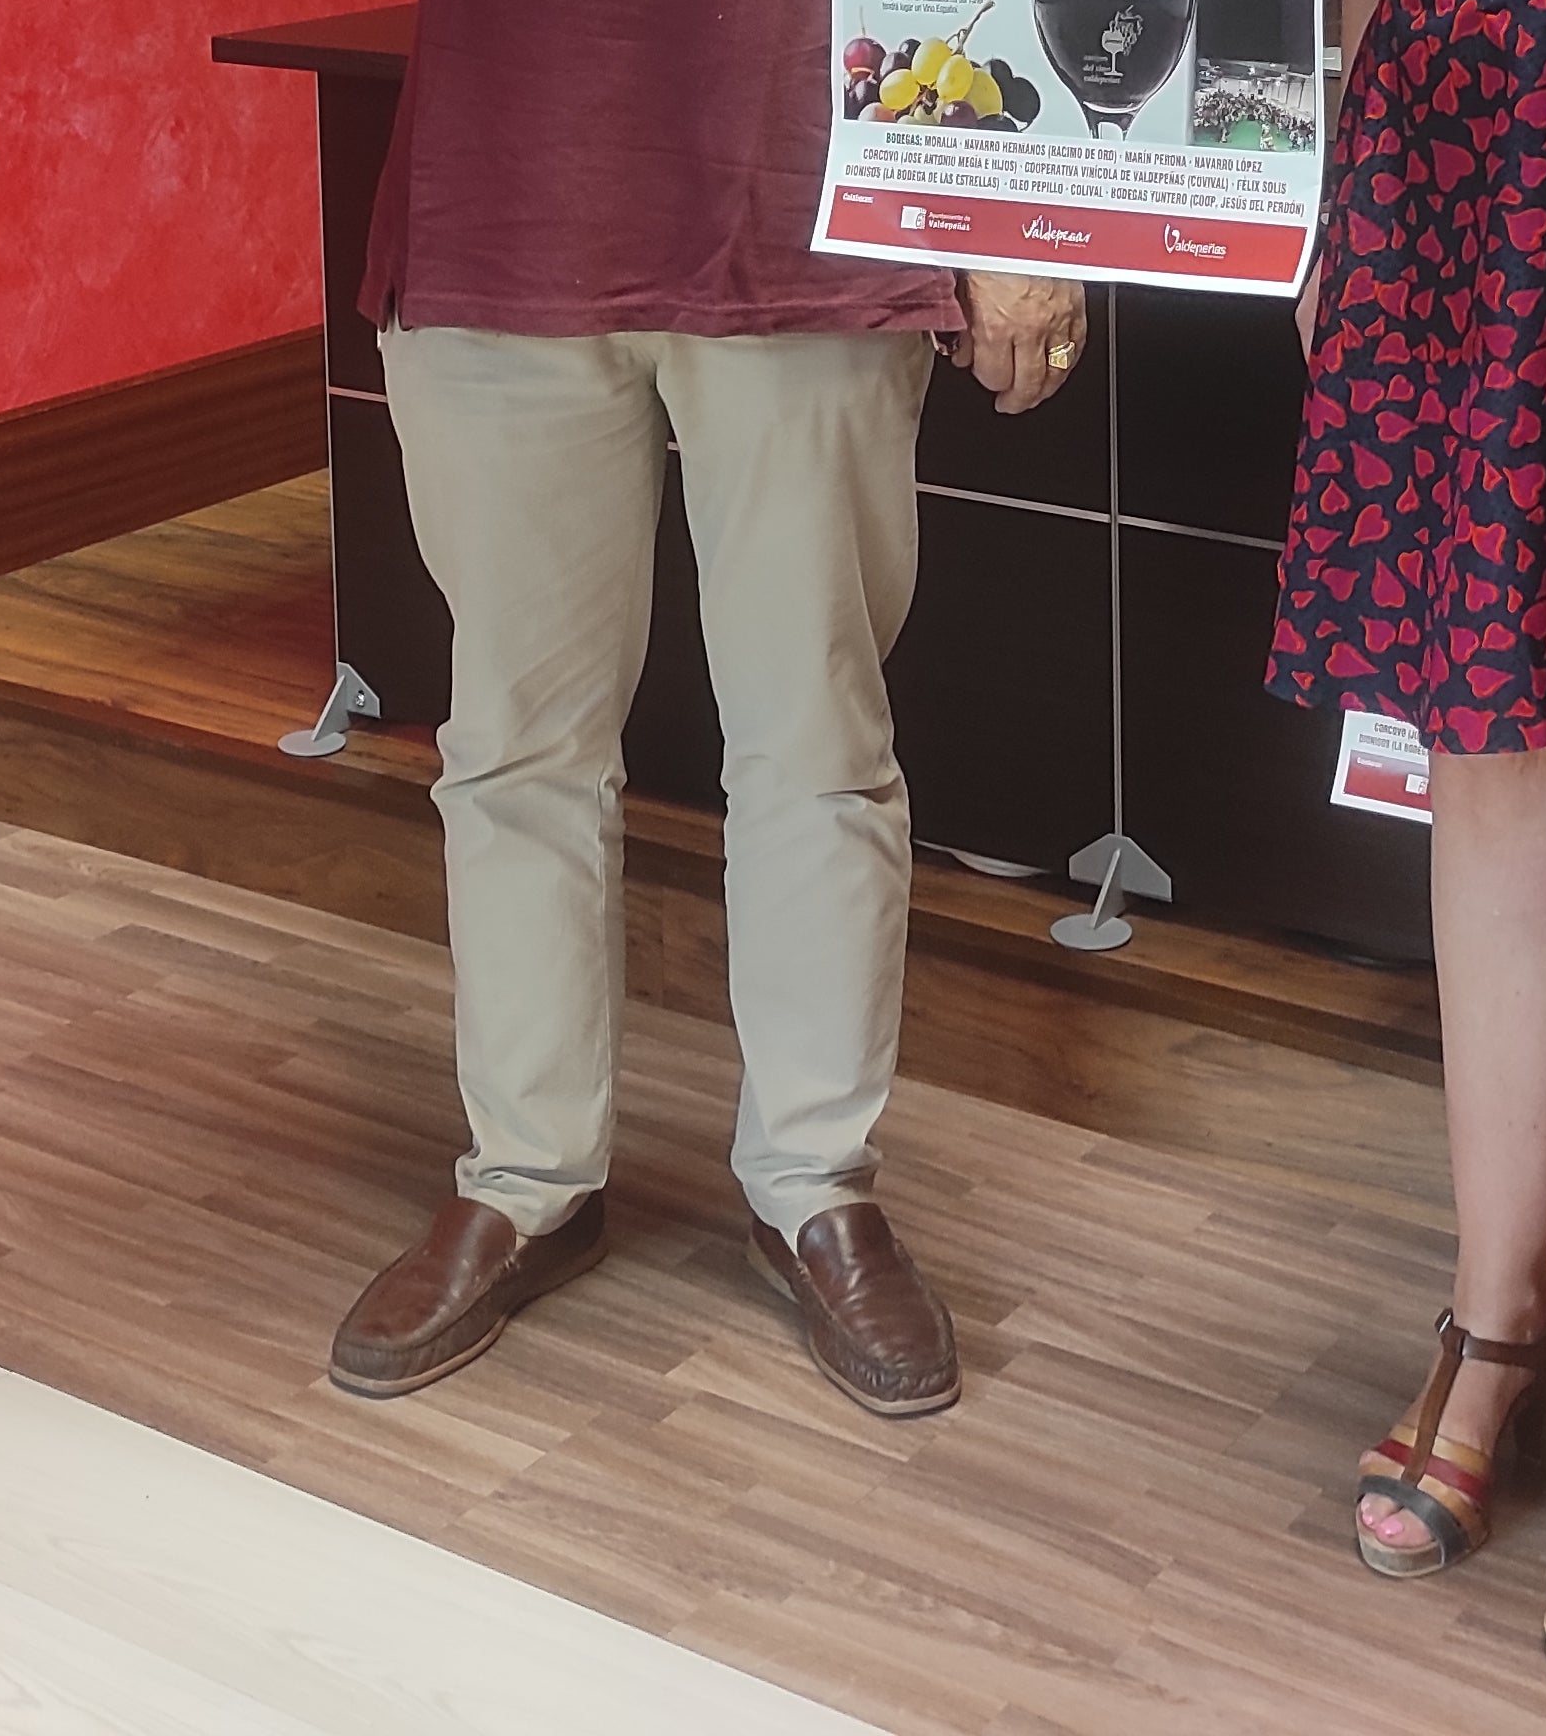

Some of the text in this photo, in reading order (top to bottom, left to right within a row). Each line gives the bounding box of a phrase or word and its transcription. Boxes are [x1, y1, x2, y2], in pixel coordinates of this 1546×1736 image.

[863, 148, 899, 162] CORCOVO
[924, 153, 956, 167] ANTONIO
[958, 153, 983, 169] MEGÍA
[984, 156, 990, 169] E
[992, 158, 1018, 174] HIJOS)
[1024, 161, 1079, 178] COOPERATIVA
[1081, 163, 1119, 180] VINÍCOLA
[1120, 169, 1131, 181] DE
[1133, 170, 1185, 186] VALDEPEÑAS
[1187, 175, 1229, 192] (COVIVAL)
[886, 132, 923, 146] BODEGAS:
[925, 136, 958, 149] MORALIA
[964, 139, 1000, 152] NAVARRO
[1002, 141, 1046, 156] HERMANOS
[1048, 145, 1083, 160] (RACIMO
[1085, 147, 1096, 160] DE
[1097, 148, 1118, 164] ORO)
[1125, 149, 1152, 164] MARÍN
[1194, 156, 1234, 171] NAVARRO
[1236, 157, 1263, 173] LÓPEZ
[845, 164, 881, 178] DIONISOS
[897, 169, 926, 183] BODEGA
[928, 172, 938, 183] DE
[940, 173, 954, 185] LAS
[956, 174, 1000, 190] ESTRELLAS)
[1031, 180, 1064, 194] PEPILLO
[1070, 184, 1104, 198] COLIVAL
[1111, 187, 1148, 202] BODEGAS
[1150, 190, 1188, 205] YUNTERO
[1220, 194, 1247, 211] JESÚS
[1249, 199, 1265, 212] DEL
[1267, 200, 1305, 217] PERDÓN)
[1164, 223, 1227, 257] Valdepeñas
